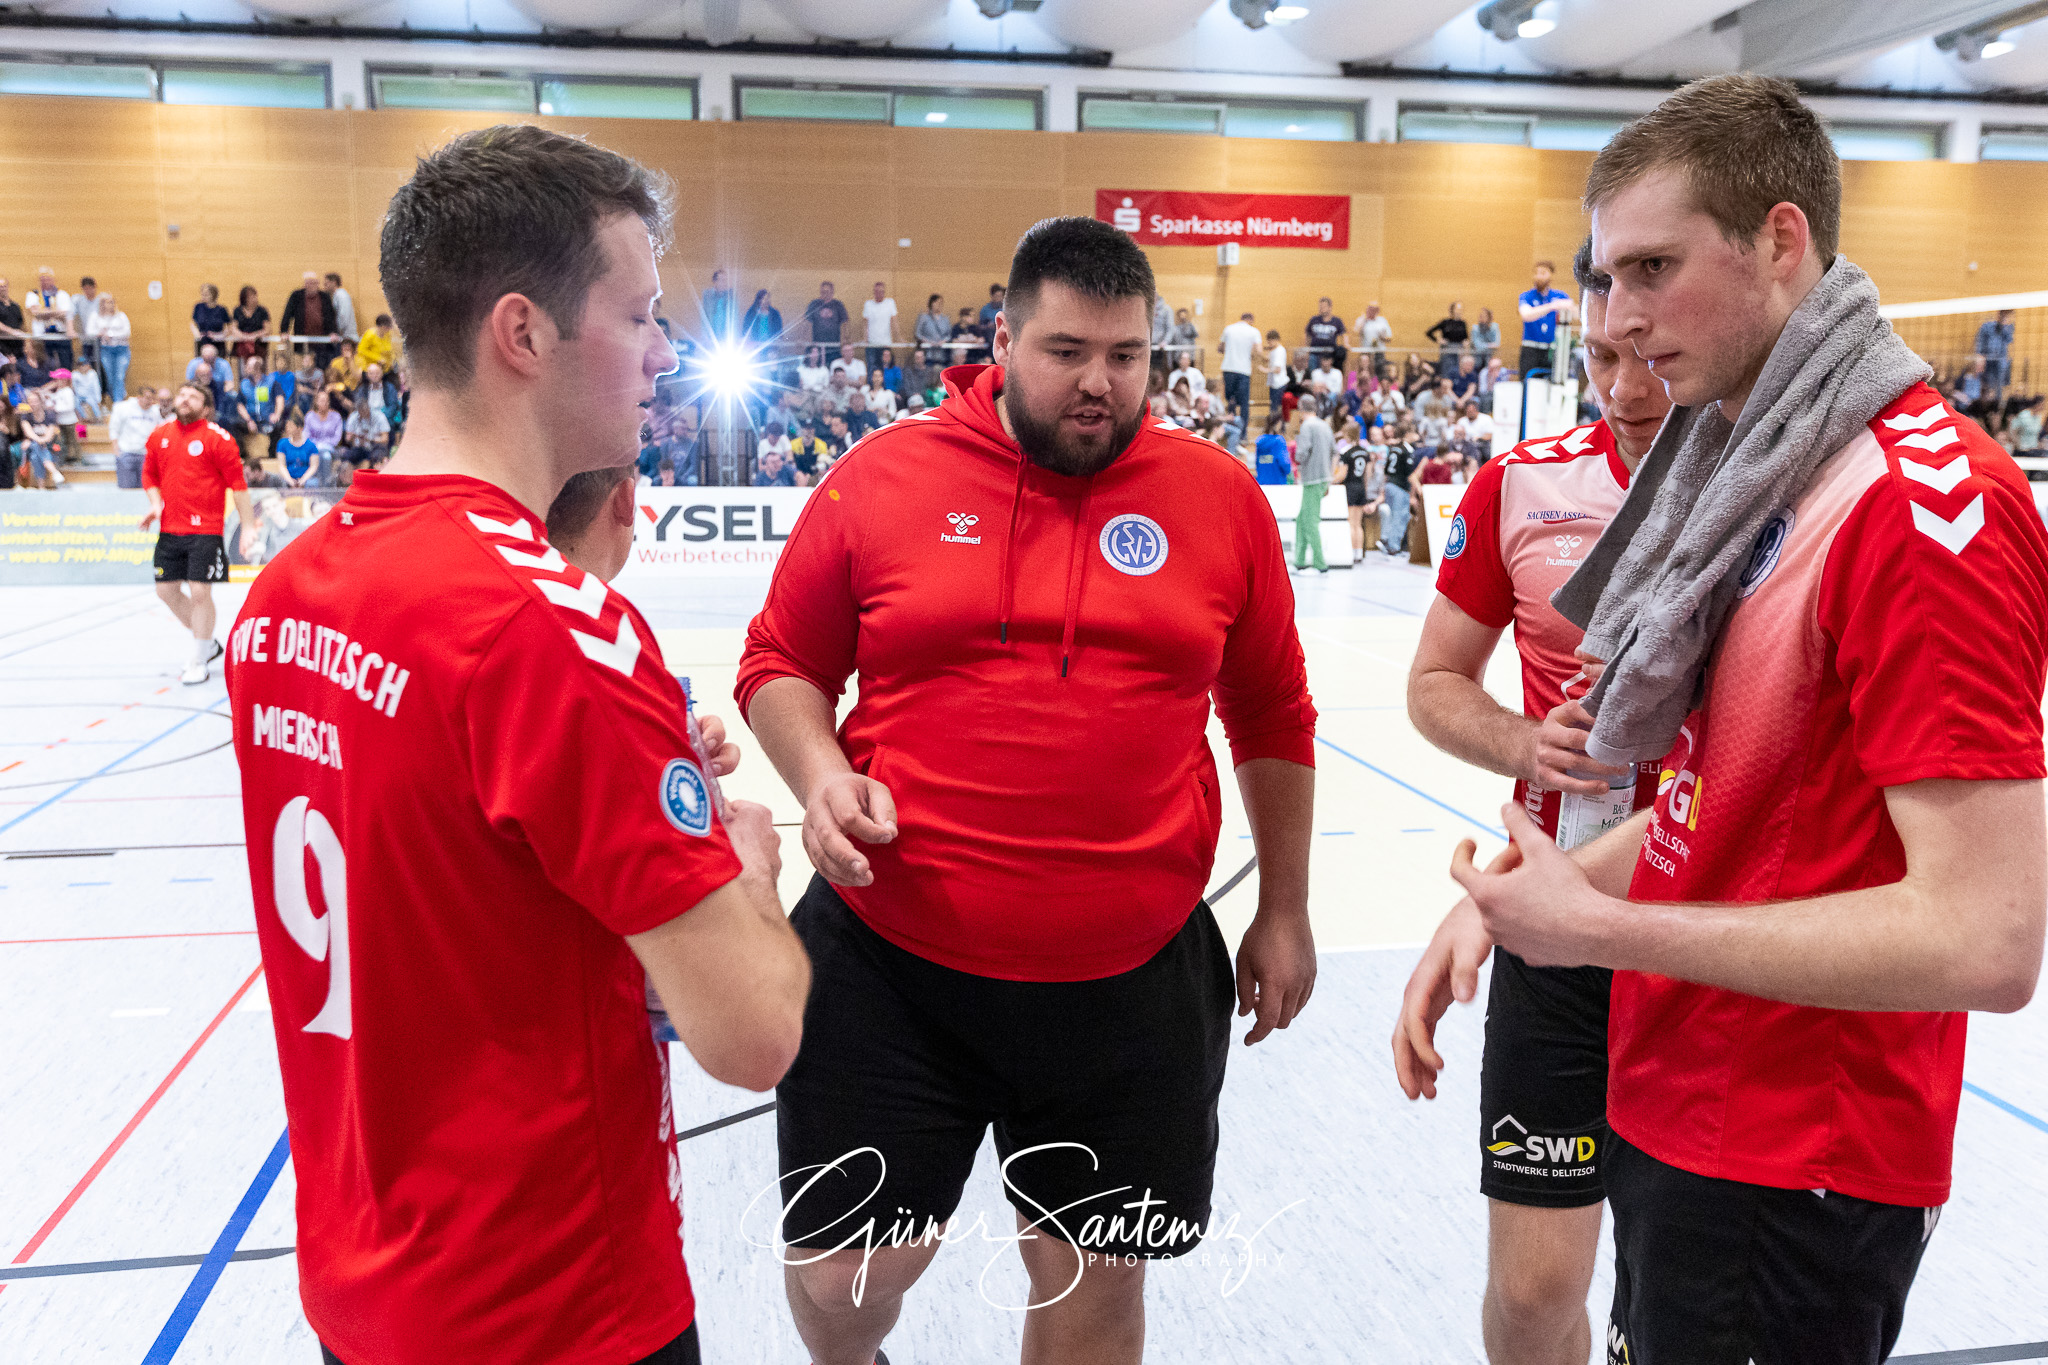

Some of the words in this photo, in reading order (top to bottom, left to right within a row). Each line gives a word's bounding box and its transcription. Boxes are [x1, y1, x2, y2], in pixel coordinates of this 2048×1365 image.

[1150, 214, 1244, 237] Sparkasse
[1247, 216, 1333, 242] Nürnberg
[634, 505, 790, 542] YSEL
[1526, 510, 1562, 520] SACHSEN
[940, 532, 981, 545] hummel
[638, 548, 780, 563] Werbetechni
[276, 617, 411, 718] DELITZSCH
[253, 703, 343, 770] MIERSCH
[272, 795, 353, 1040] 9
[1526, 1135, 1596, 1163] SWD
[1493, 1160, 1549, 1177] STADTWERKE
[1552, 1165, 1596, 1177] DELITZSCH
